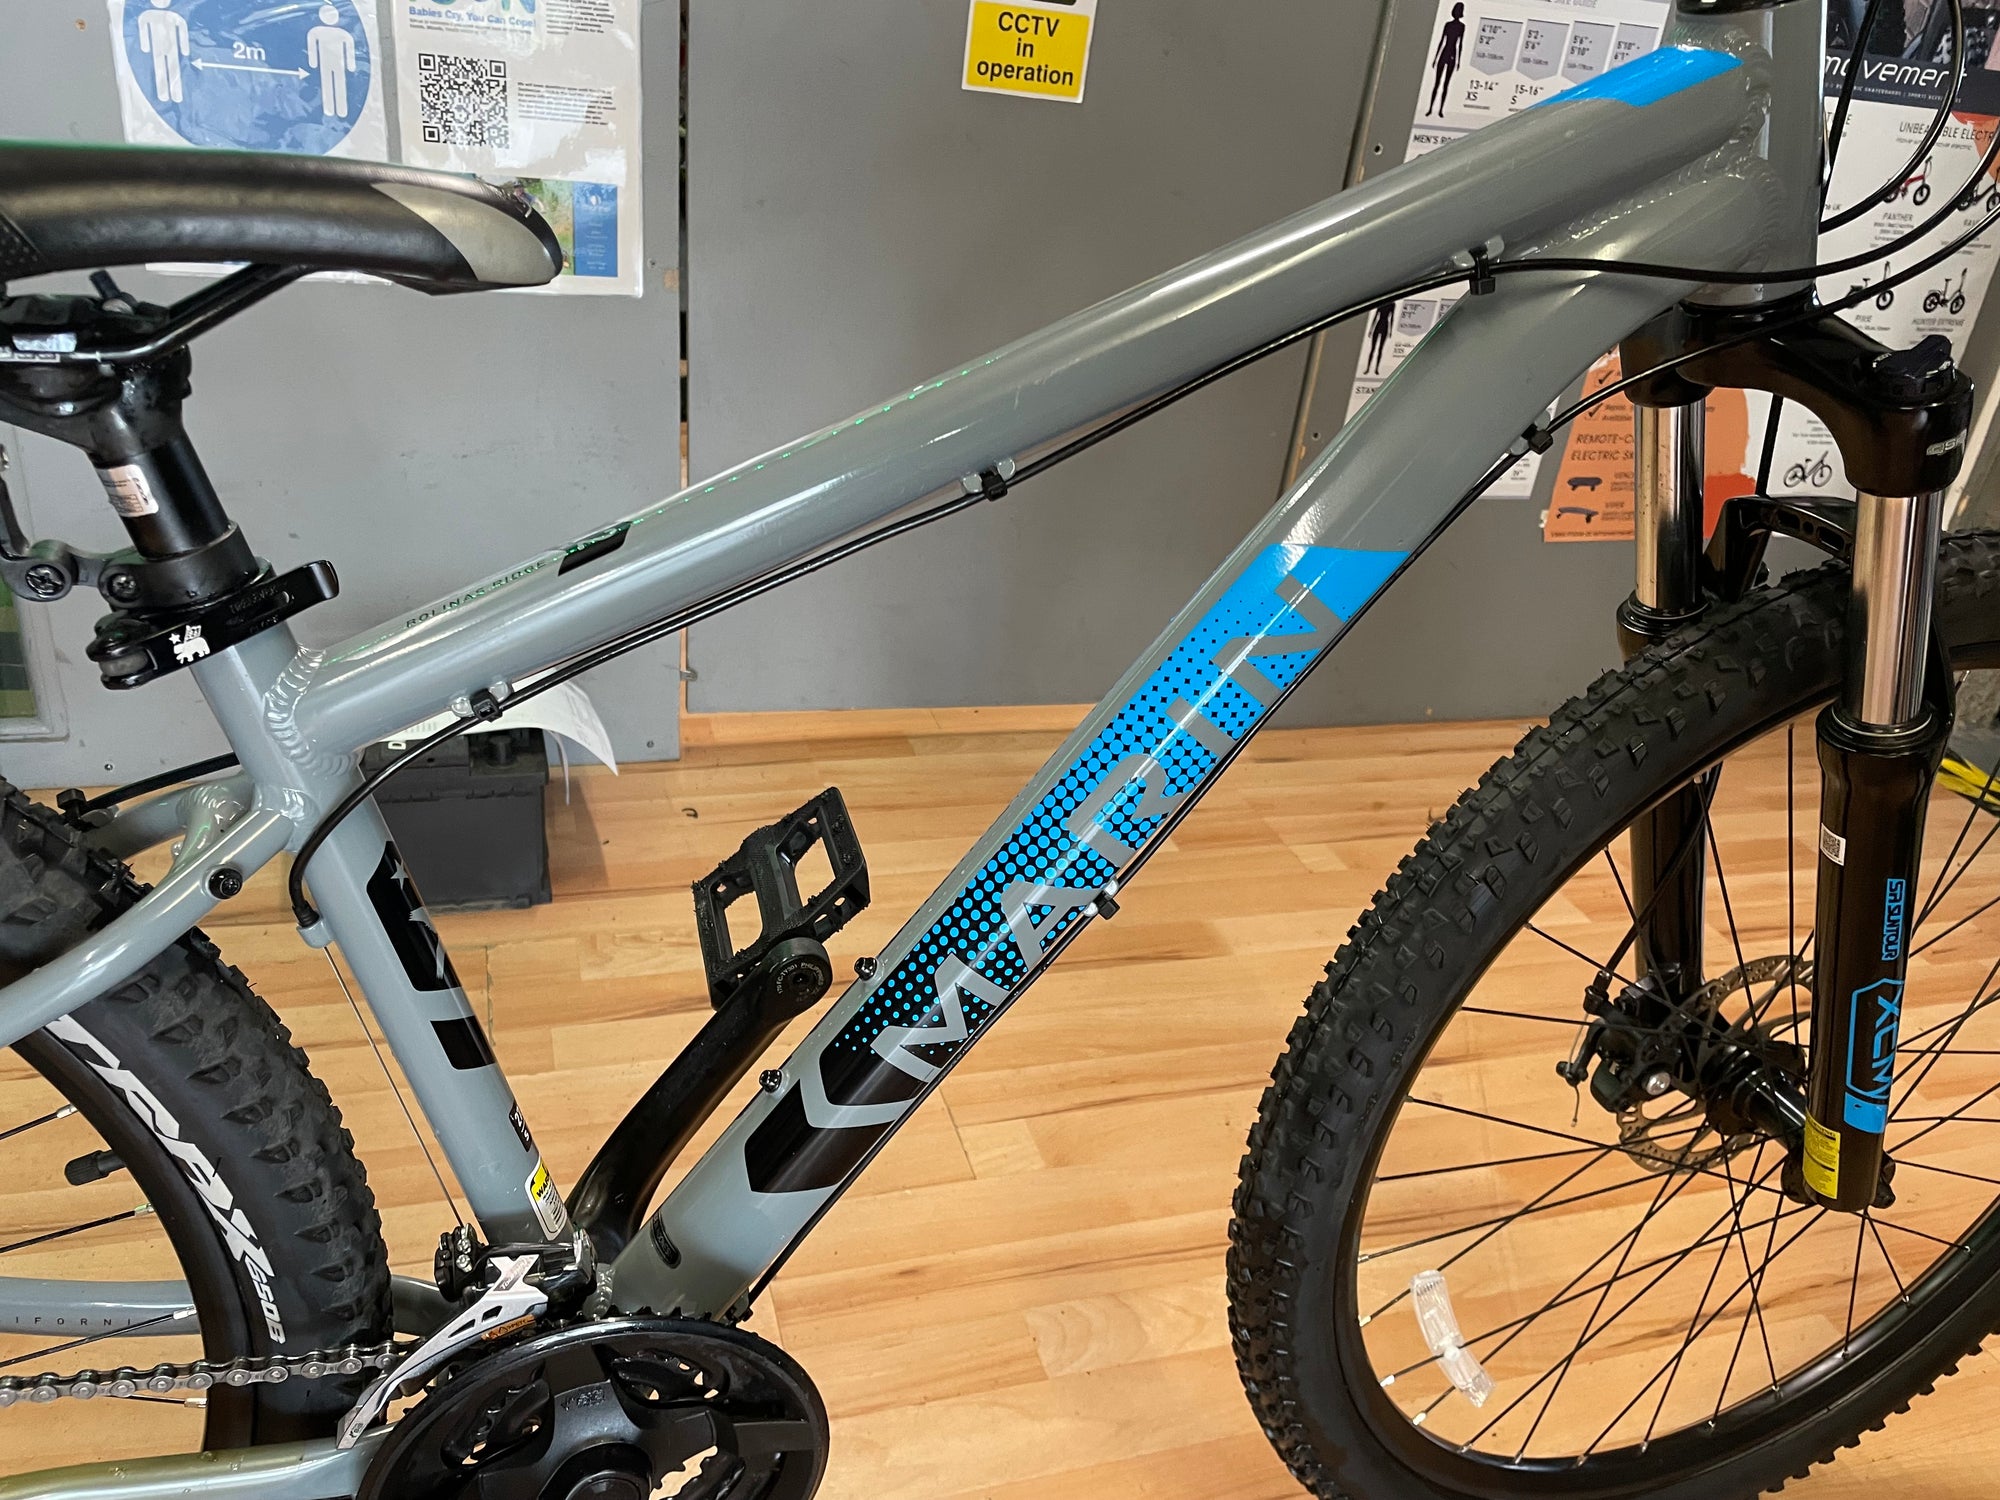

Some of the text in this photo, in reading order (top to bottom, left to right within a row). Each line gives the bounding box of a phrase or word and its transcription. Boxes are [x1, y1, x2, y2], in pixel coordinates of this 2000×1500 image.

[409, 6, 442, 18] Babies
[445, 10, 464, 21] Cry,
[466, 12, 485, 22] You
[487, 14, 506, 24] Can
[509, 16, 536, 27] Cope!
[998, 11, 1060, 37] CCTV
[232, 41, 266, 61] 2m
[1016, 37, 1034, 58] in
[976, 61, 1074, 86] operation
[1465, 91, 1479, 101] XS
[1510, 95, 1518, 105] S
[1413, 134, 1441, 144] MEN'S
[1571, 450, 1619, 461] ELECTRIC
[405, 586, 486, 628] BOLINAS
[491, 560, 548, 590] RIDGE
[871, 574, 1350, 1083] MARIN
[1885, 904, 1902, 959] SUNTOUR
[244, 1255, 287, 1345] 650B
